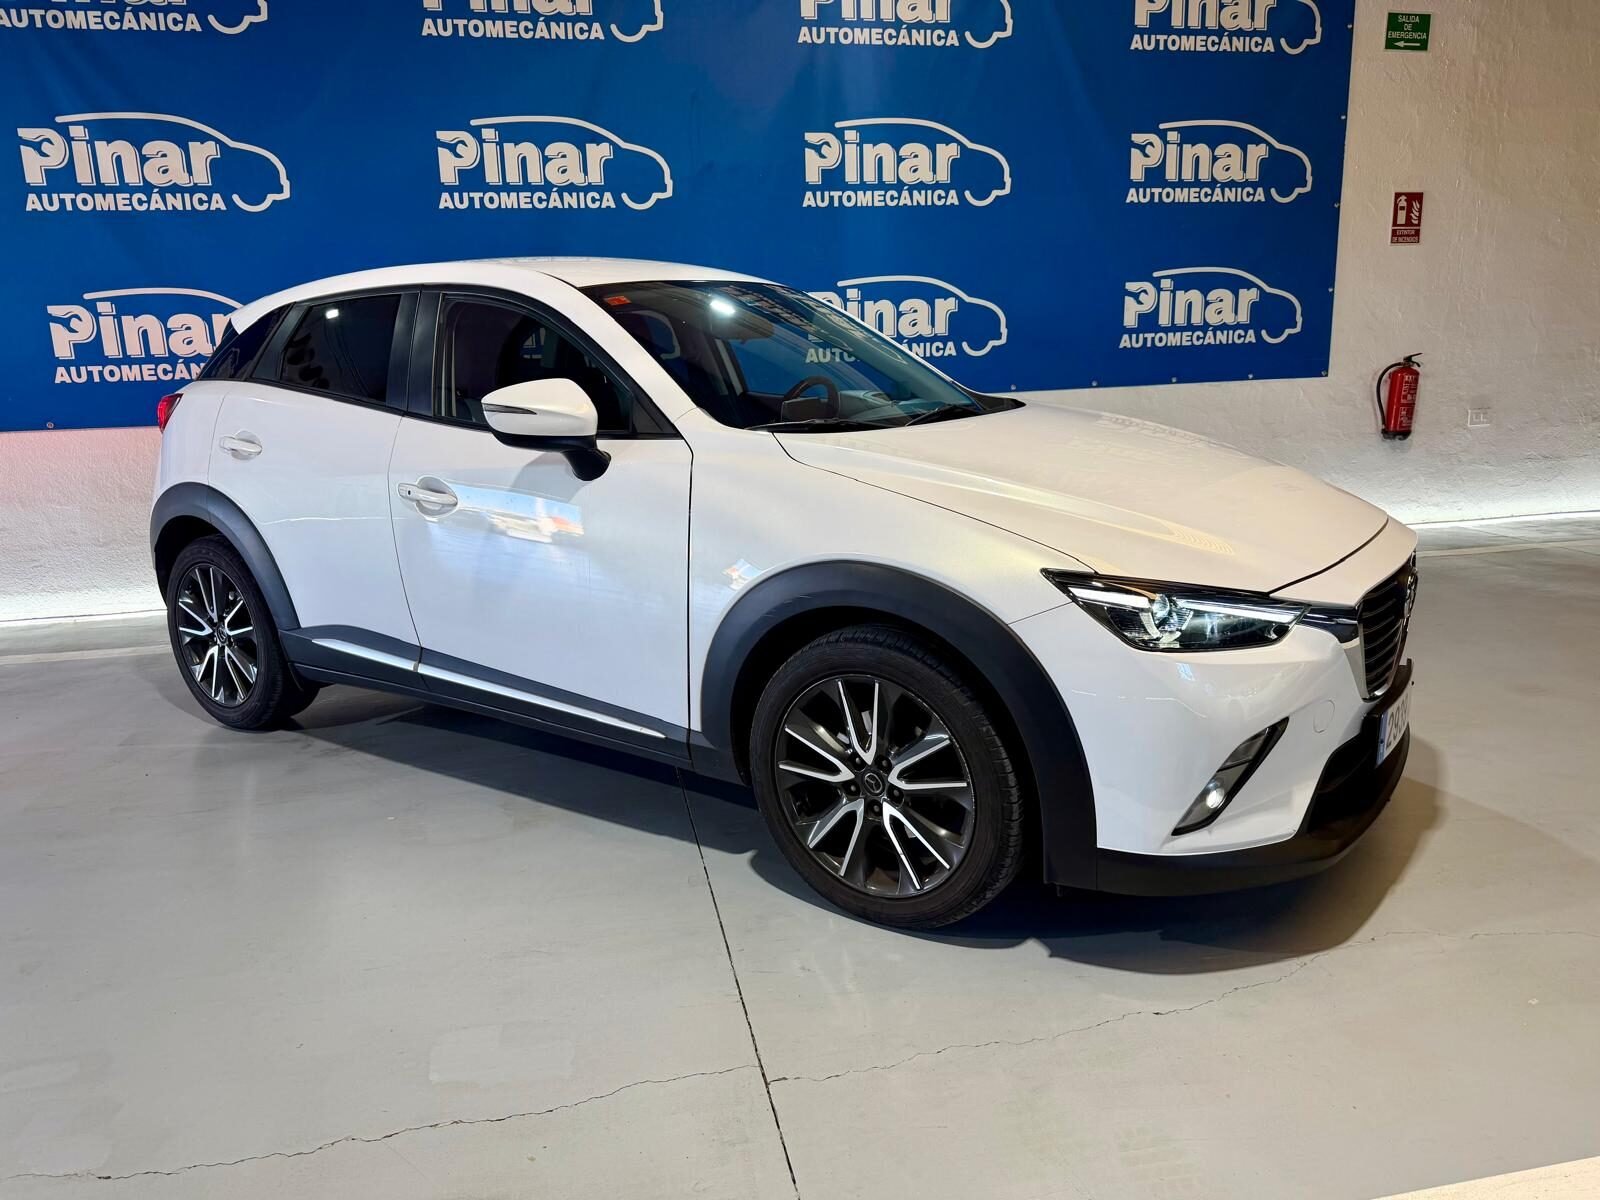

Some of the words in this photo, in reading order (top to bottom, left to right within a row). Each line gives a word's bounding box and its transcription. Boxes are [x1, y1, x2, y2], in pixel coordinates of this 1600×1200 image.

[0, 7, 202, 32] AUTOMECÁNICA
[421, 17, 605, 40] AUTOMECÁNICA
[1397, 15, 1420, 23] SALIDA
[1403, 23, 1413, 31] DE
[797, 25, 960, 47] AUTOMECÁNICA
[1130, 32, 1275, 53] AUTOMECÁNICA
[1387, 31, 1427, 40] EMERGENCIA
[17, 126, 221, 187] Pinar
[435, 128, 614, 187] Pinar
[804, 130, 960, 185] Pinar
[1130, 132, 1269, 183] Pinar
[25, 188, 227, 212] AUTOMECÁNICA
[438, 187, 616, 210] AUTOMECÁNICA
[802, 186, 959, 208] AUTOMECÁNICA
[1125, 184, 1266, 203] AUTOMECÁNICA
[1122, 279, 1261, 328] Pinar
[1118, 328, 1257, 349] AUTOMECÁNICA
[54, 359, 206, 384] AUTOMECÁN
